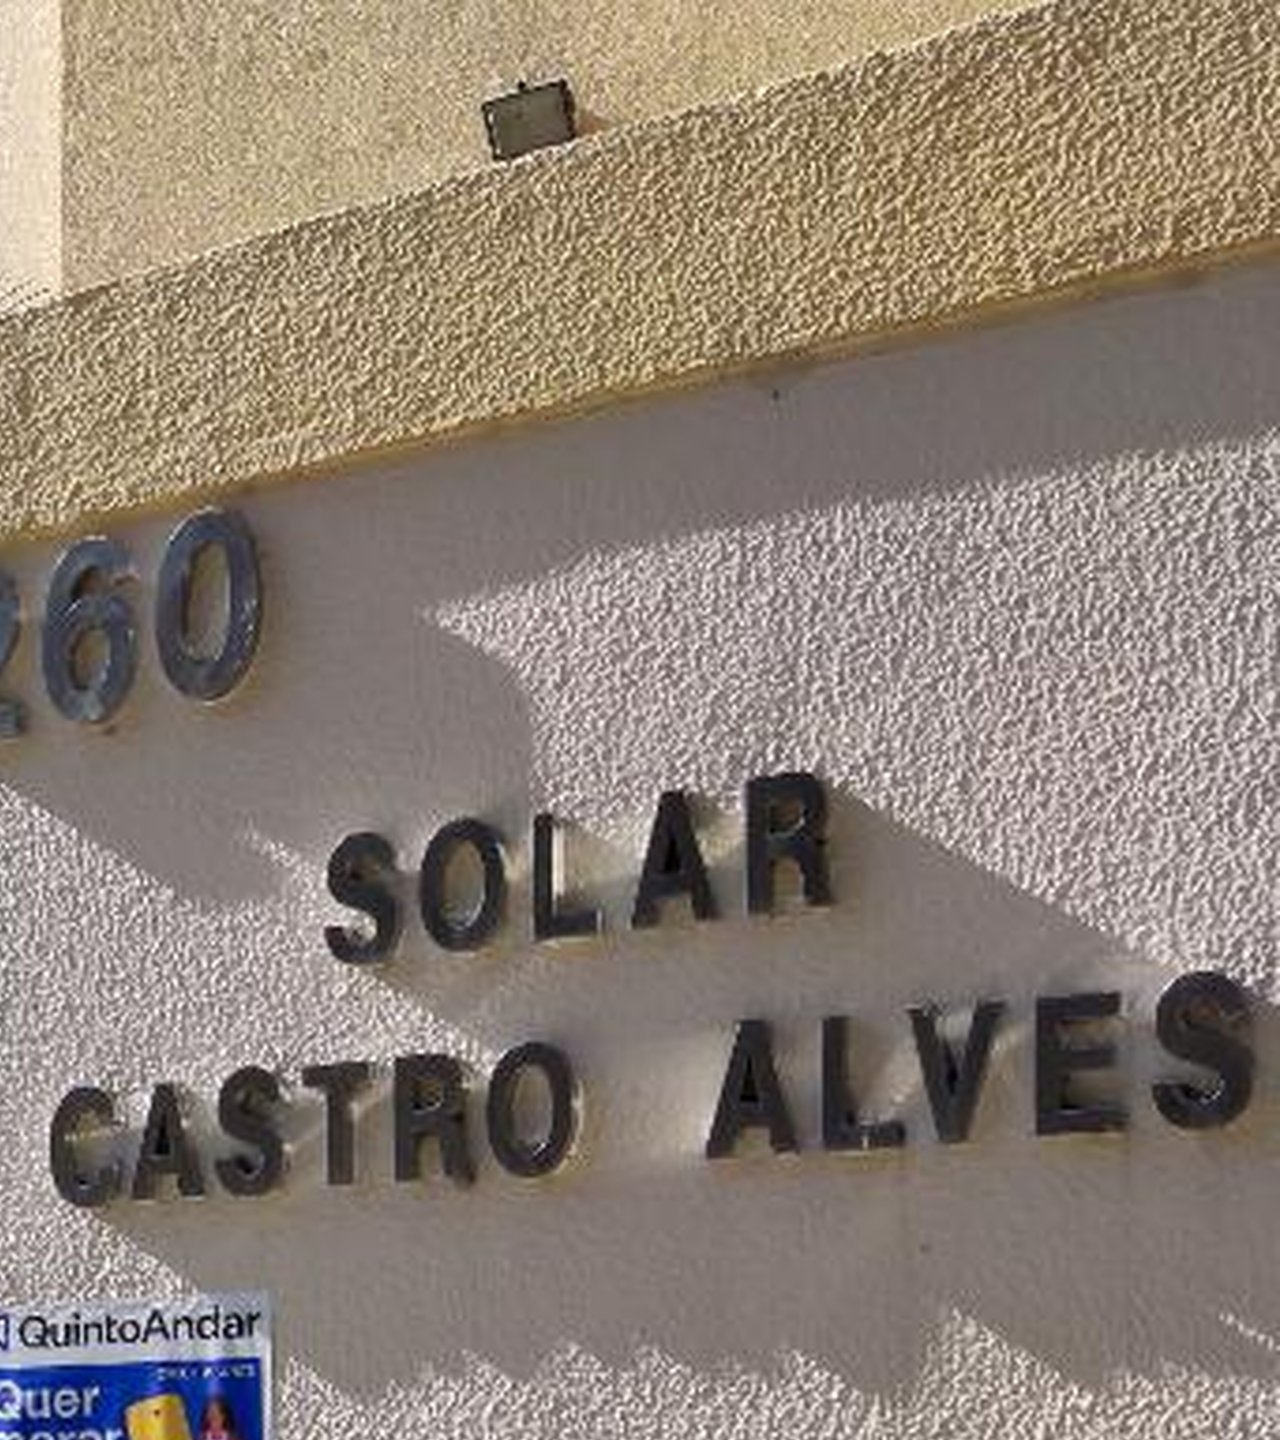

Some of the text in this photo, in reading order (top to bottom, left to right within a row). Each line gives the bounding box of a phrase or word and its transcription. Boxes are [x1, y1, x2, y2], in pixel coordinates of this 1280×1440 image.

[326, 770, 833, 964] SOLAR
[49, 969, 1255, 1207] CASTRO ALVES
[19, 1306, 260, 1348] QuintoAndar
